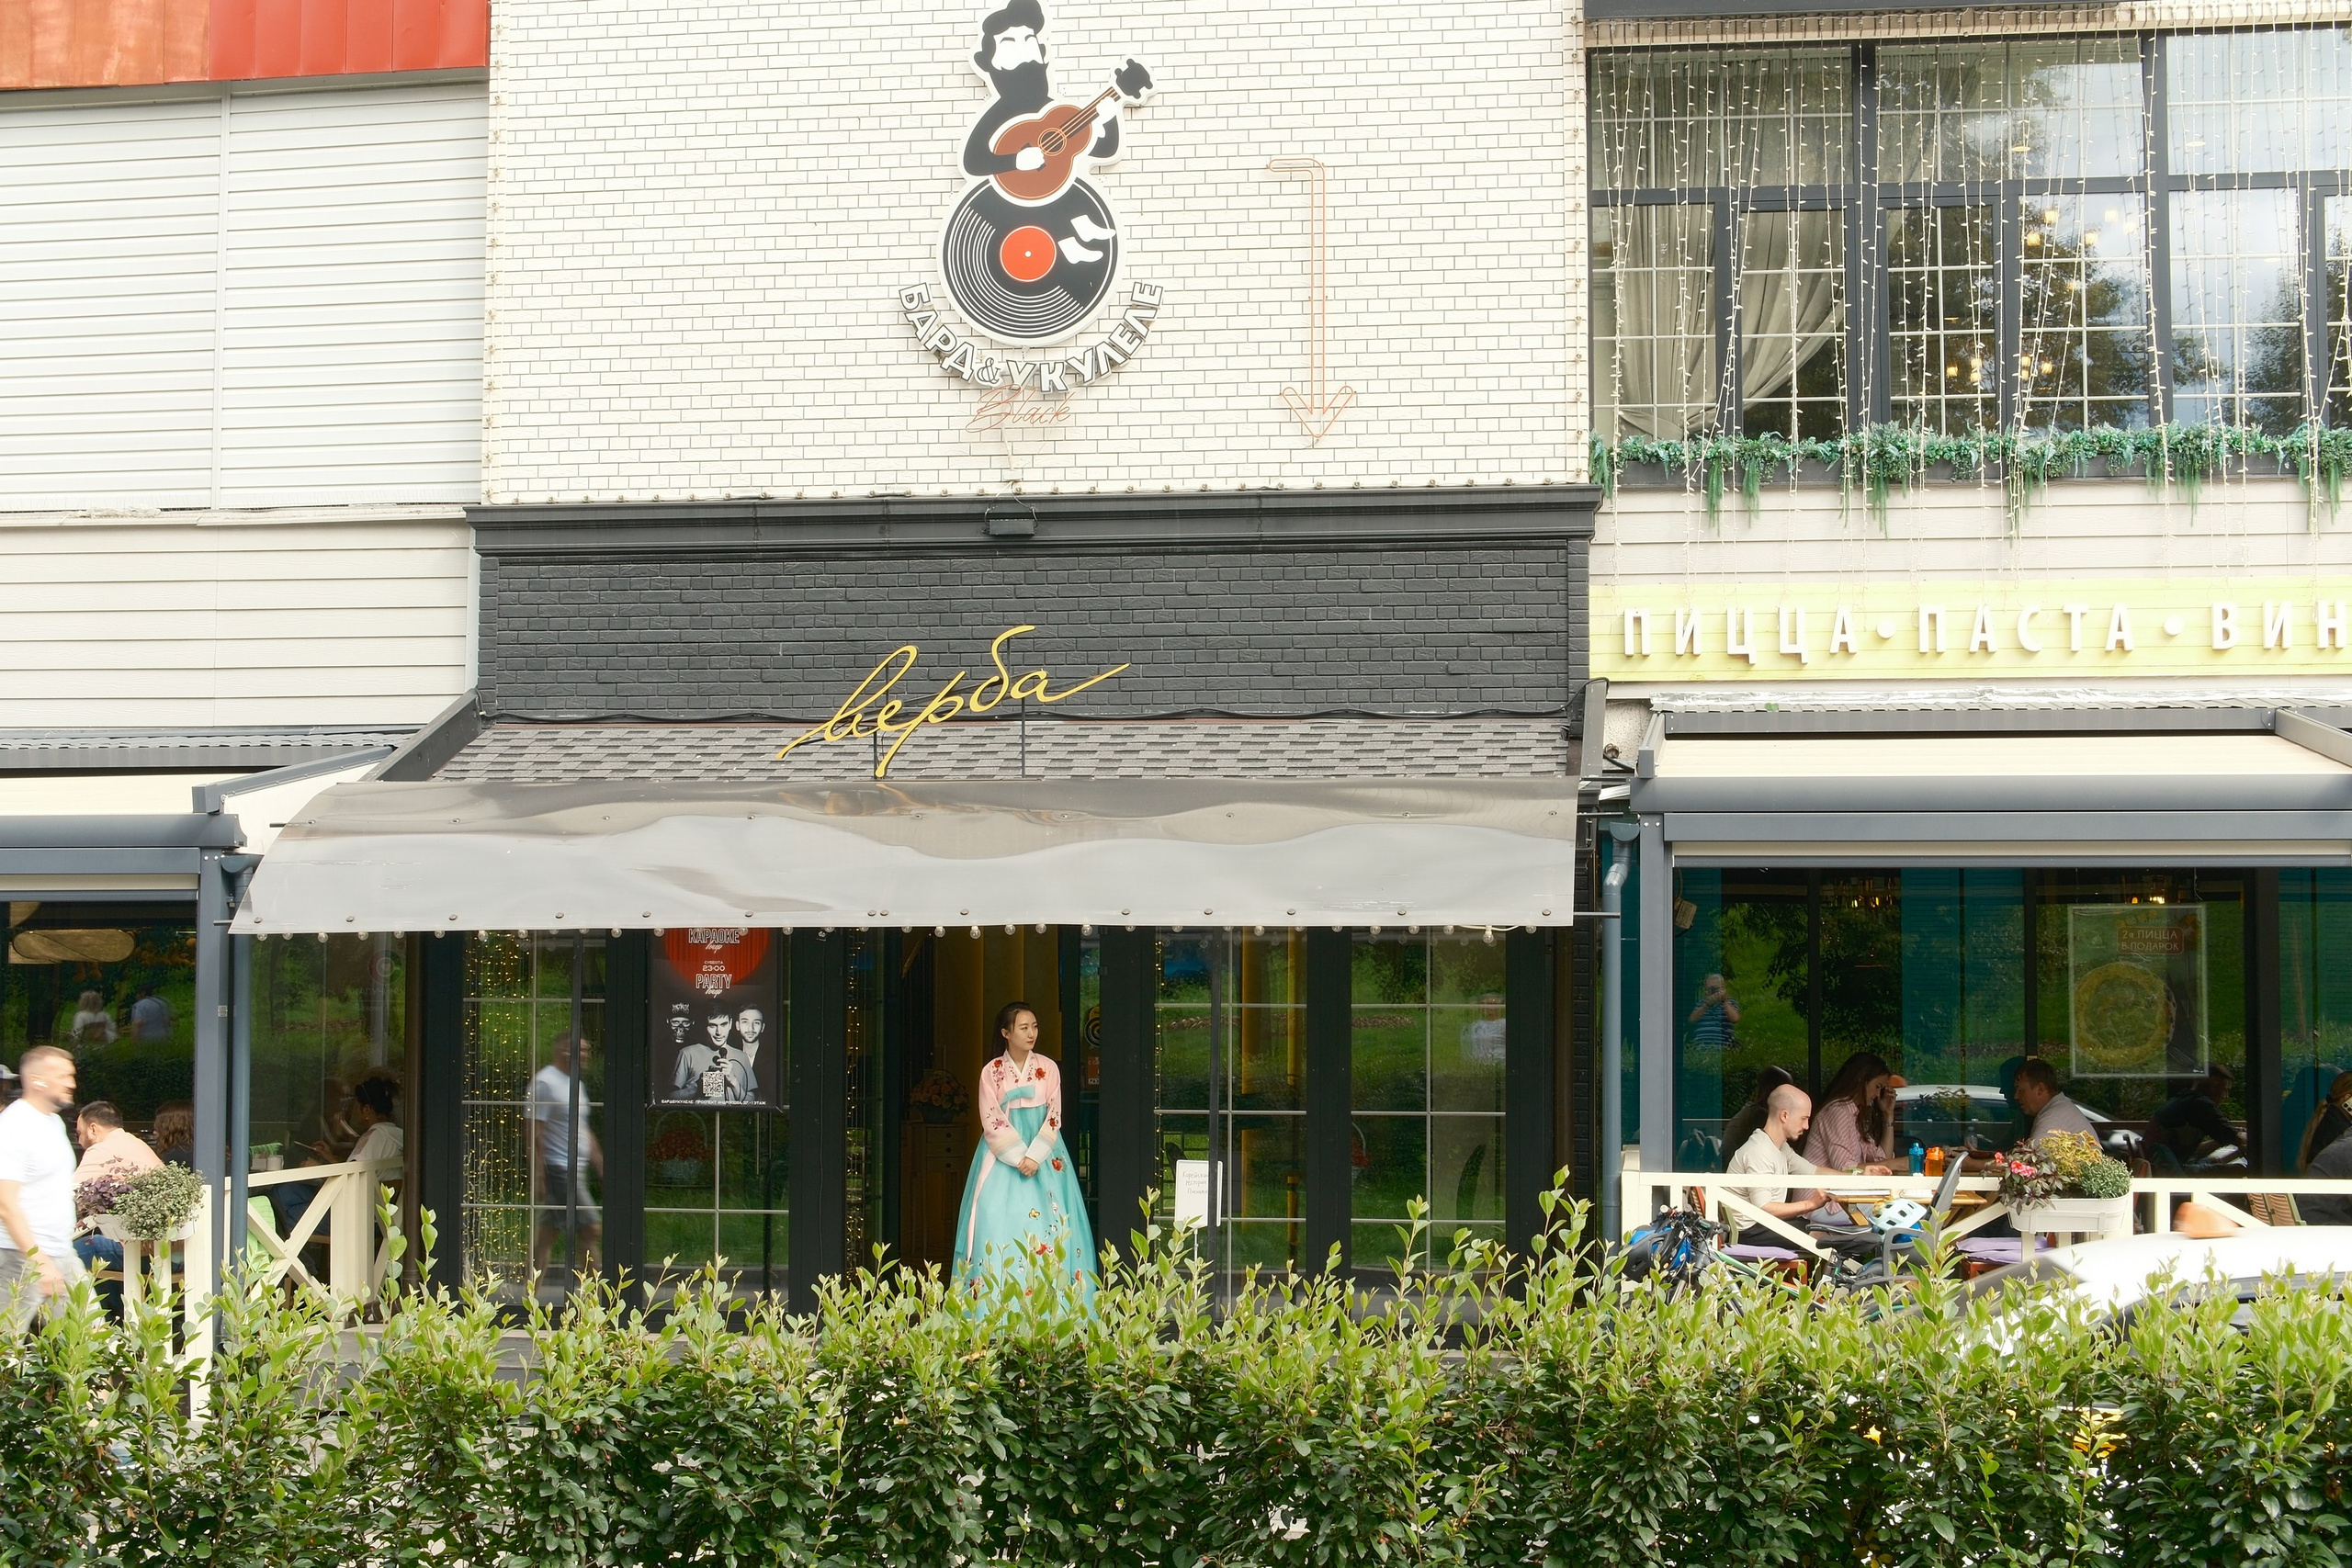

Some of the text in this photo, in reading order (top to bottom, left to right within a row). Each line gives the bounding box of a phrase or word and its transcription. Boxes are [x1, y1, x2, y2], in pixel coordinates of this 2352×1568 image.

[965, 383, 1076, 434] Black
[1623, 598, 2349, 666] ПИЦЦА ПАСТА ВИН
[775, 624, 1131, 778] верба
[688, 928, 740, 943] КАРАОКЕ
[2137, 930, 2177, 941] ПИЦЦА
[2131, 942, 2179, 952] ПОДАРОК
[695, 974, 732, 988] PARTY
